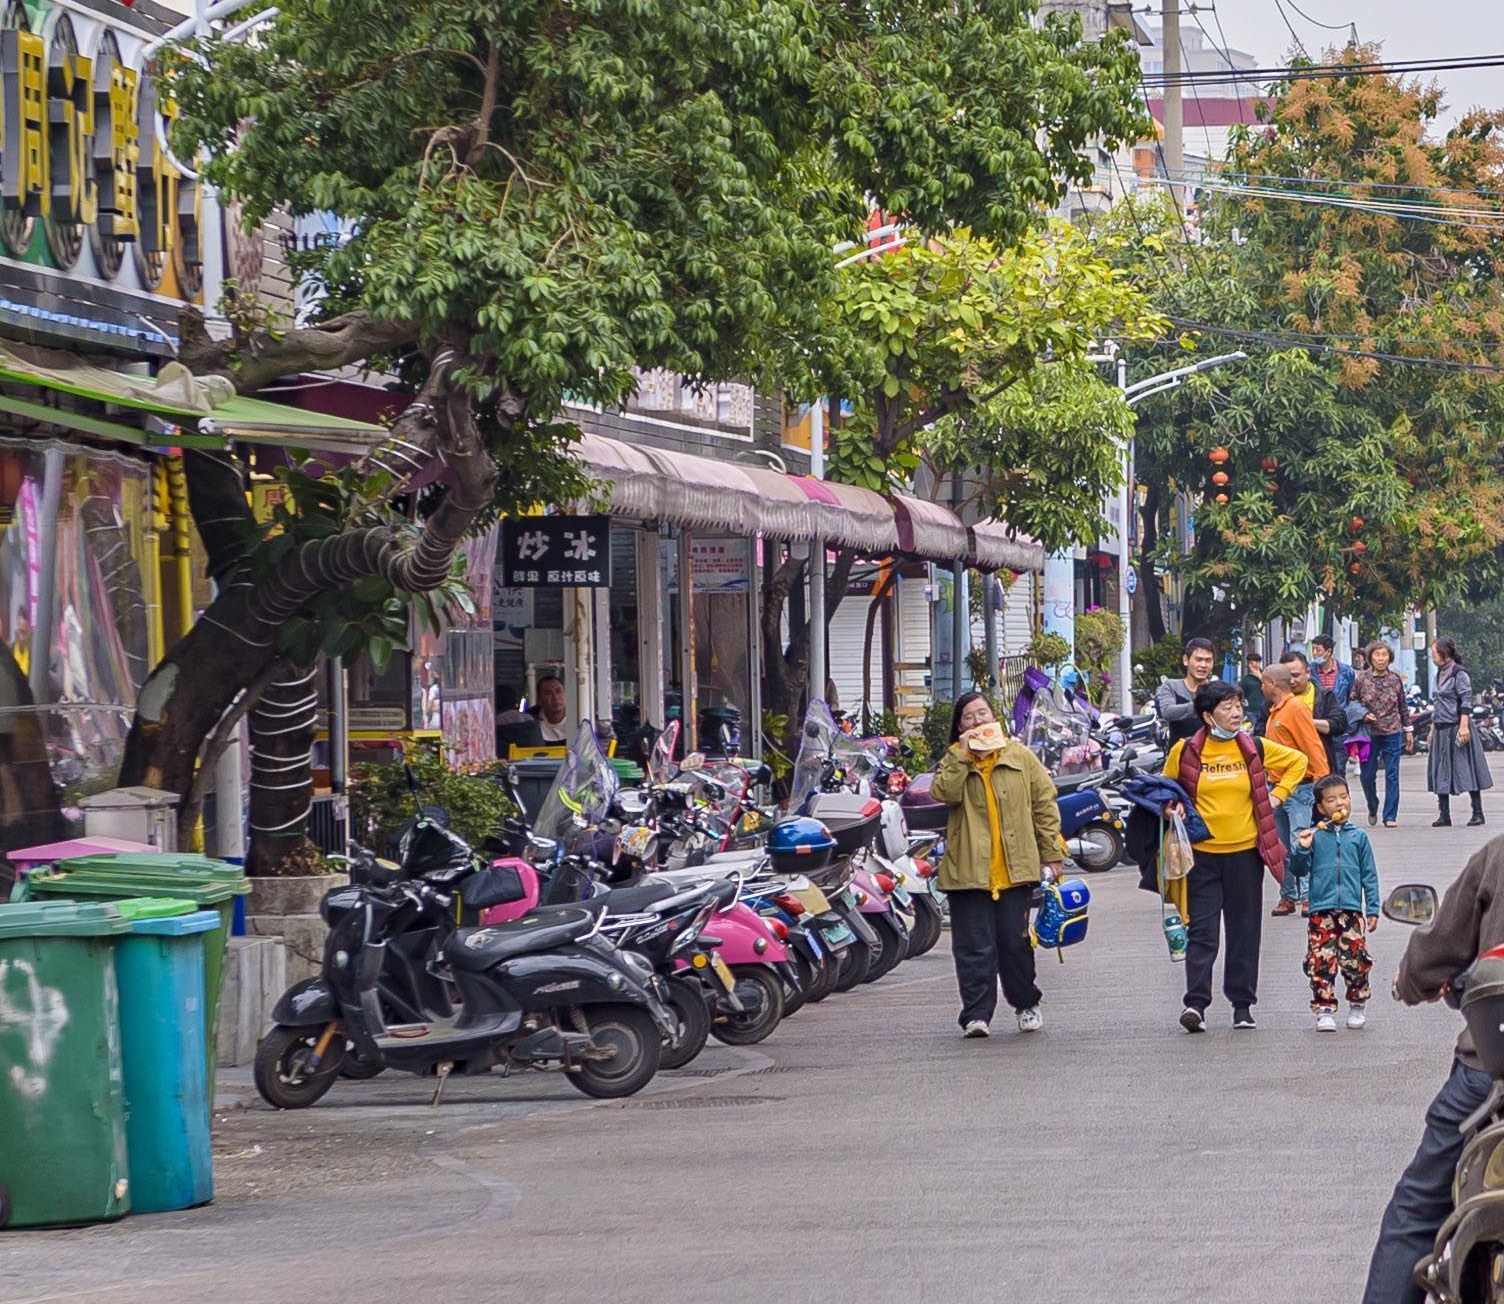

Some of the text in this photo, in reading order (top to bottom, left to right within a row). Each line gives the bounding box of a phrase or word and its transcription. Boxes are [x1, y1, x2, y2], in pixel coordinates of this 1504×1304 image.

[516, 530, 597, 561] 炒冰
[547, 570, 601, 583] 原汁原味
[1201, 762, 1246, 774] Refresh
